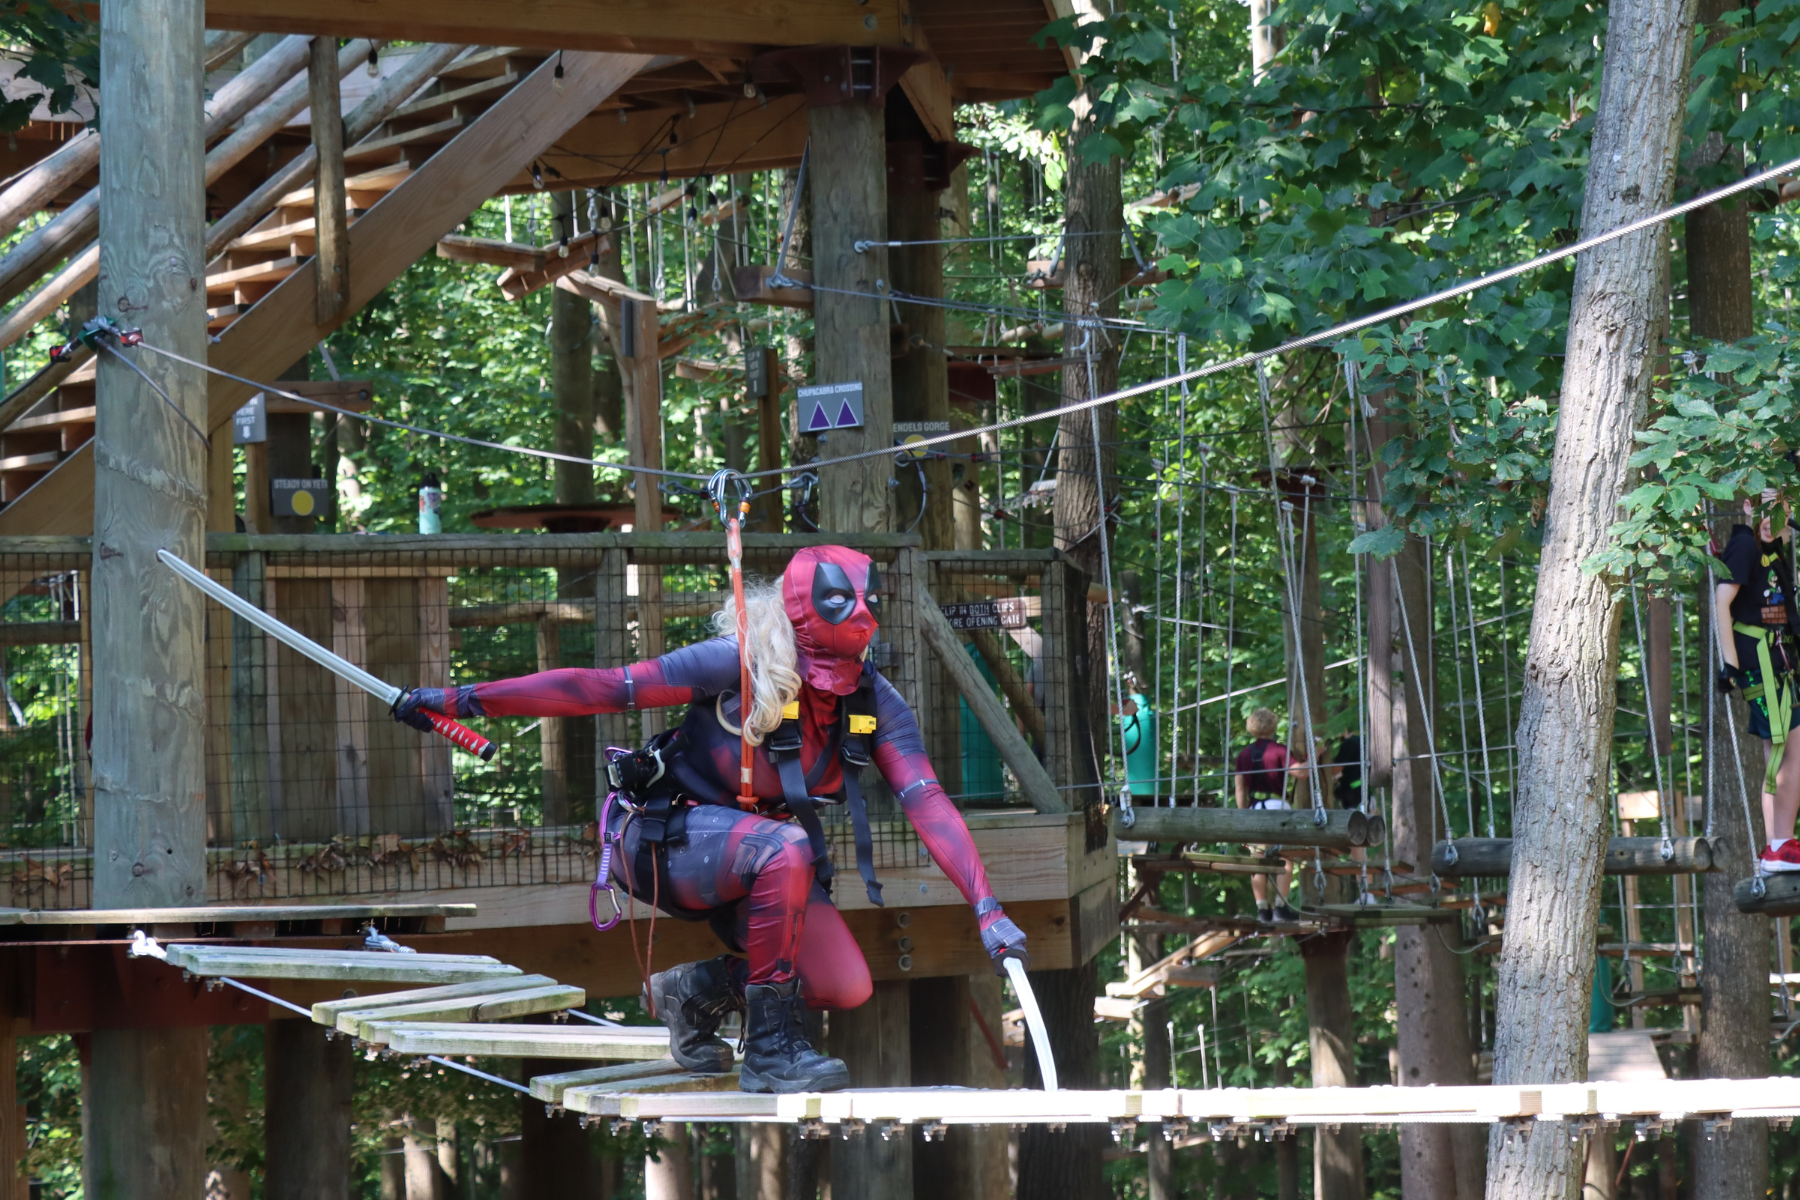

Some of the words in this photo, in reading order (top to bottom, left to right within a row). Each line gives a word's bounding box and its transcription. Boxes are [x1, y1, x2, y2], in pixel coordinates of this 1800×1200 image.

[797, 386, 834, 398] CHUPACABRA
[834, 382, 863, 393] CROSSING
[892, 422, 923, 433] ENDELS
[923, 421, 950, 432] GORGE
[940, 606, 956, 617] LIP
[969, 604, 990, 616] BOTH
[1000, 614, 1021, 625] GATE
